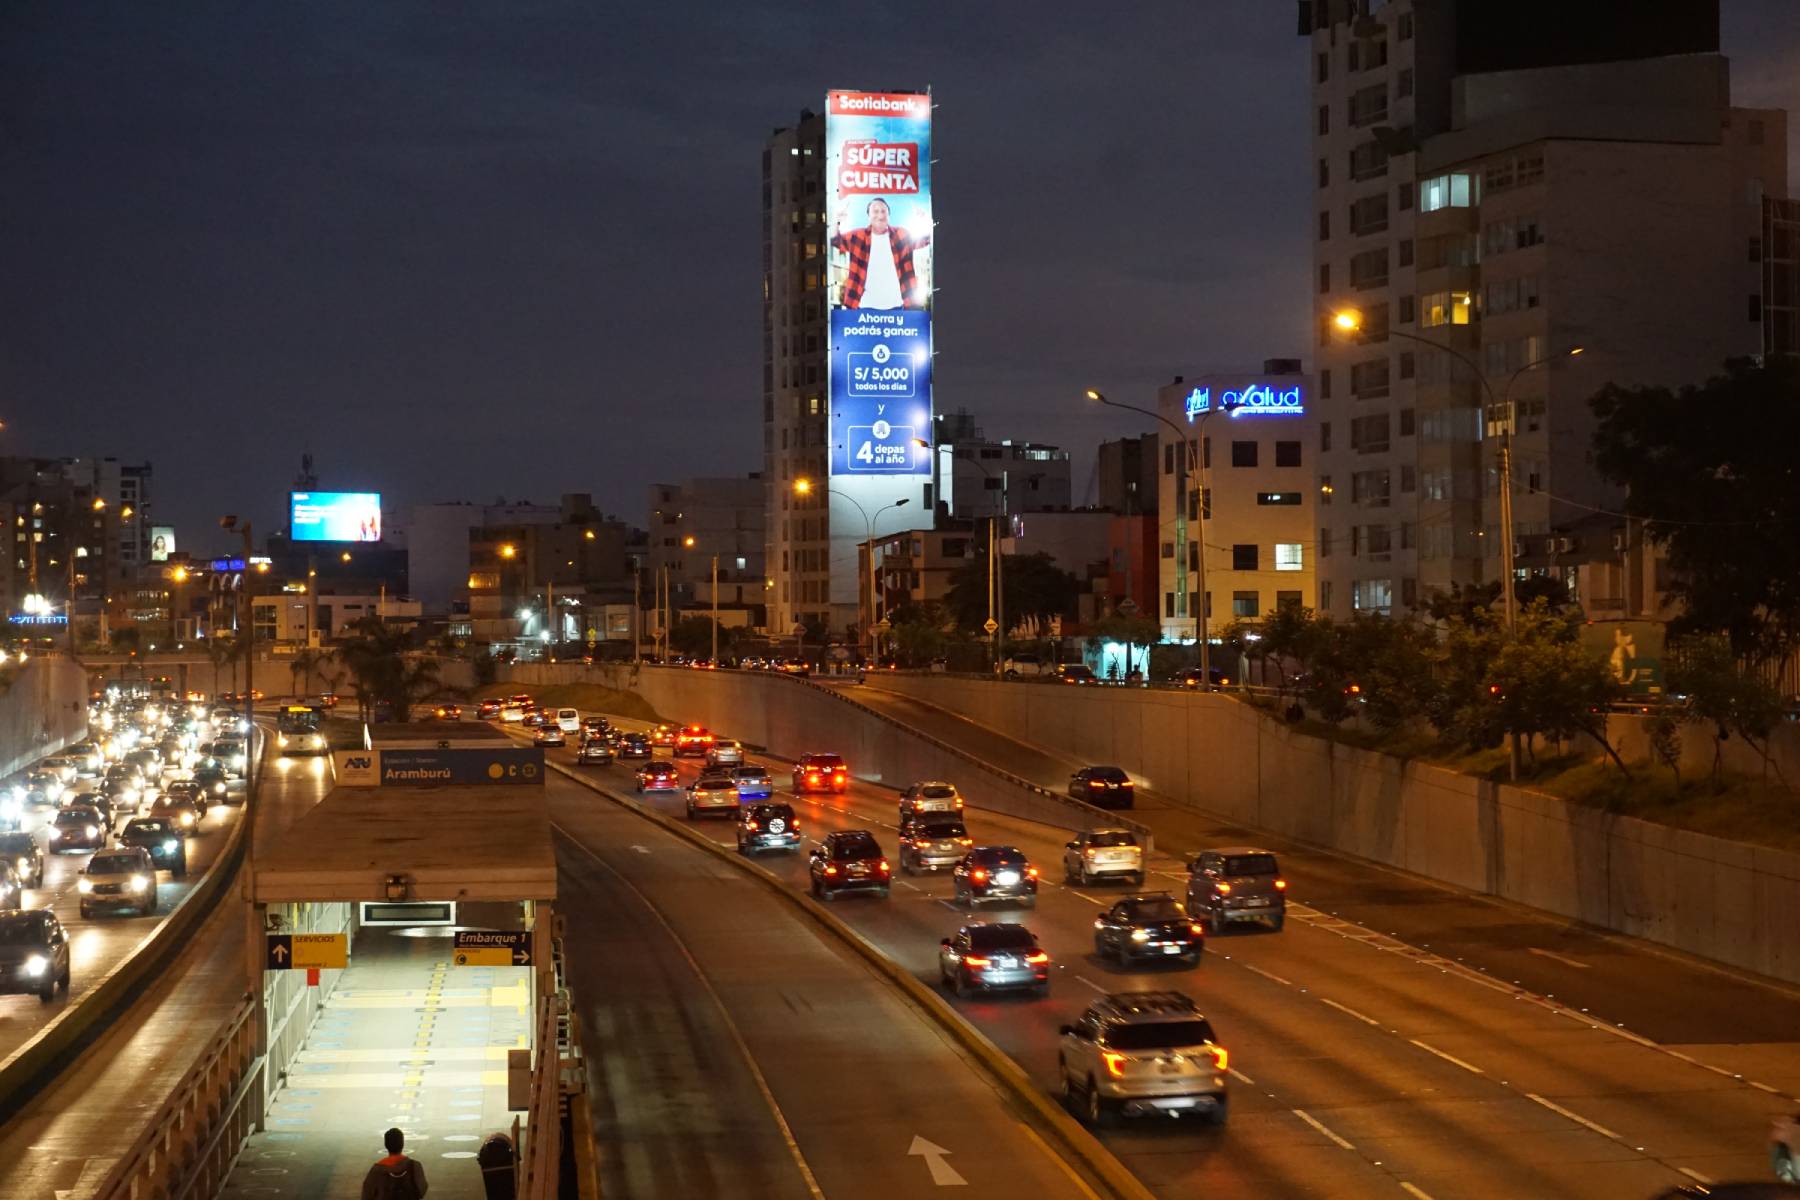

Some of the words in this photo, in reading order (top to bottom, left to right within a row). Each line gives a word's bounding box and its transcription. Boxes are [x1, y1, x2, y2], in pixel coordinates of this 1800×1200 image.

[839, 95, 916, 111] Scotiabank
[847, 144, 911, 166] SÚPER
[841, 170, 917, 190] CUENTA
[858, 313, 895, 324] Ahorra
[896, 316, 904, 325] y
[844, 326, 882, 337] podrás
[883, 328, 918, 338] ganar:
[854, 367, 869, 381] S/
[871, 367, 908, 382] 5,000
[855, 383, 878, 391] todos
[878, 383, 890, 391] los
[878, 403, 885, 414] y
[856, 440, 874, 464] 4
[875, 444, 905, 456] depas
[875, 454, 887, 464] al
[887, 453, 905, 464] año
[385, 767, 451, 779] Aramburú
[459, 932, 517, 945] Embarque
[520, 933, 526, 943] 1
